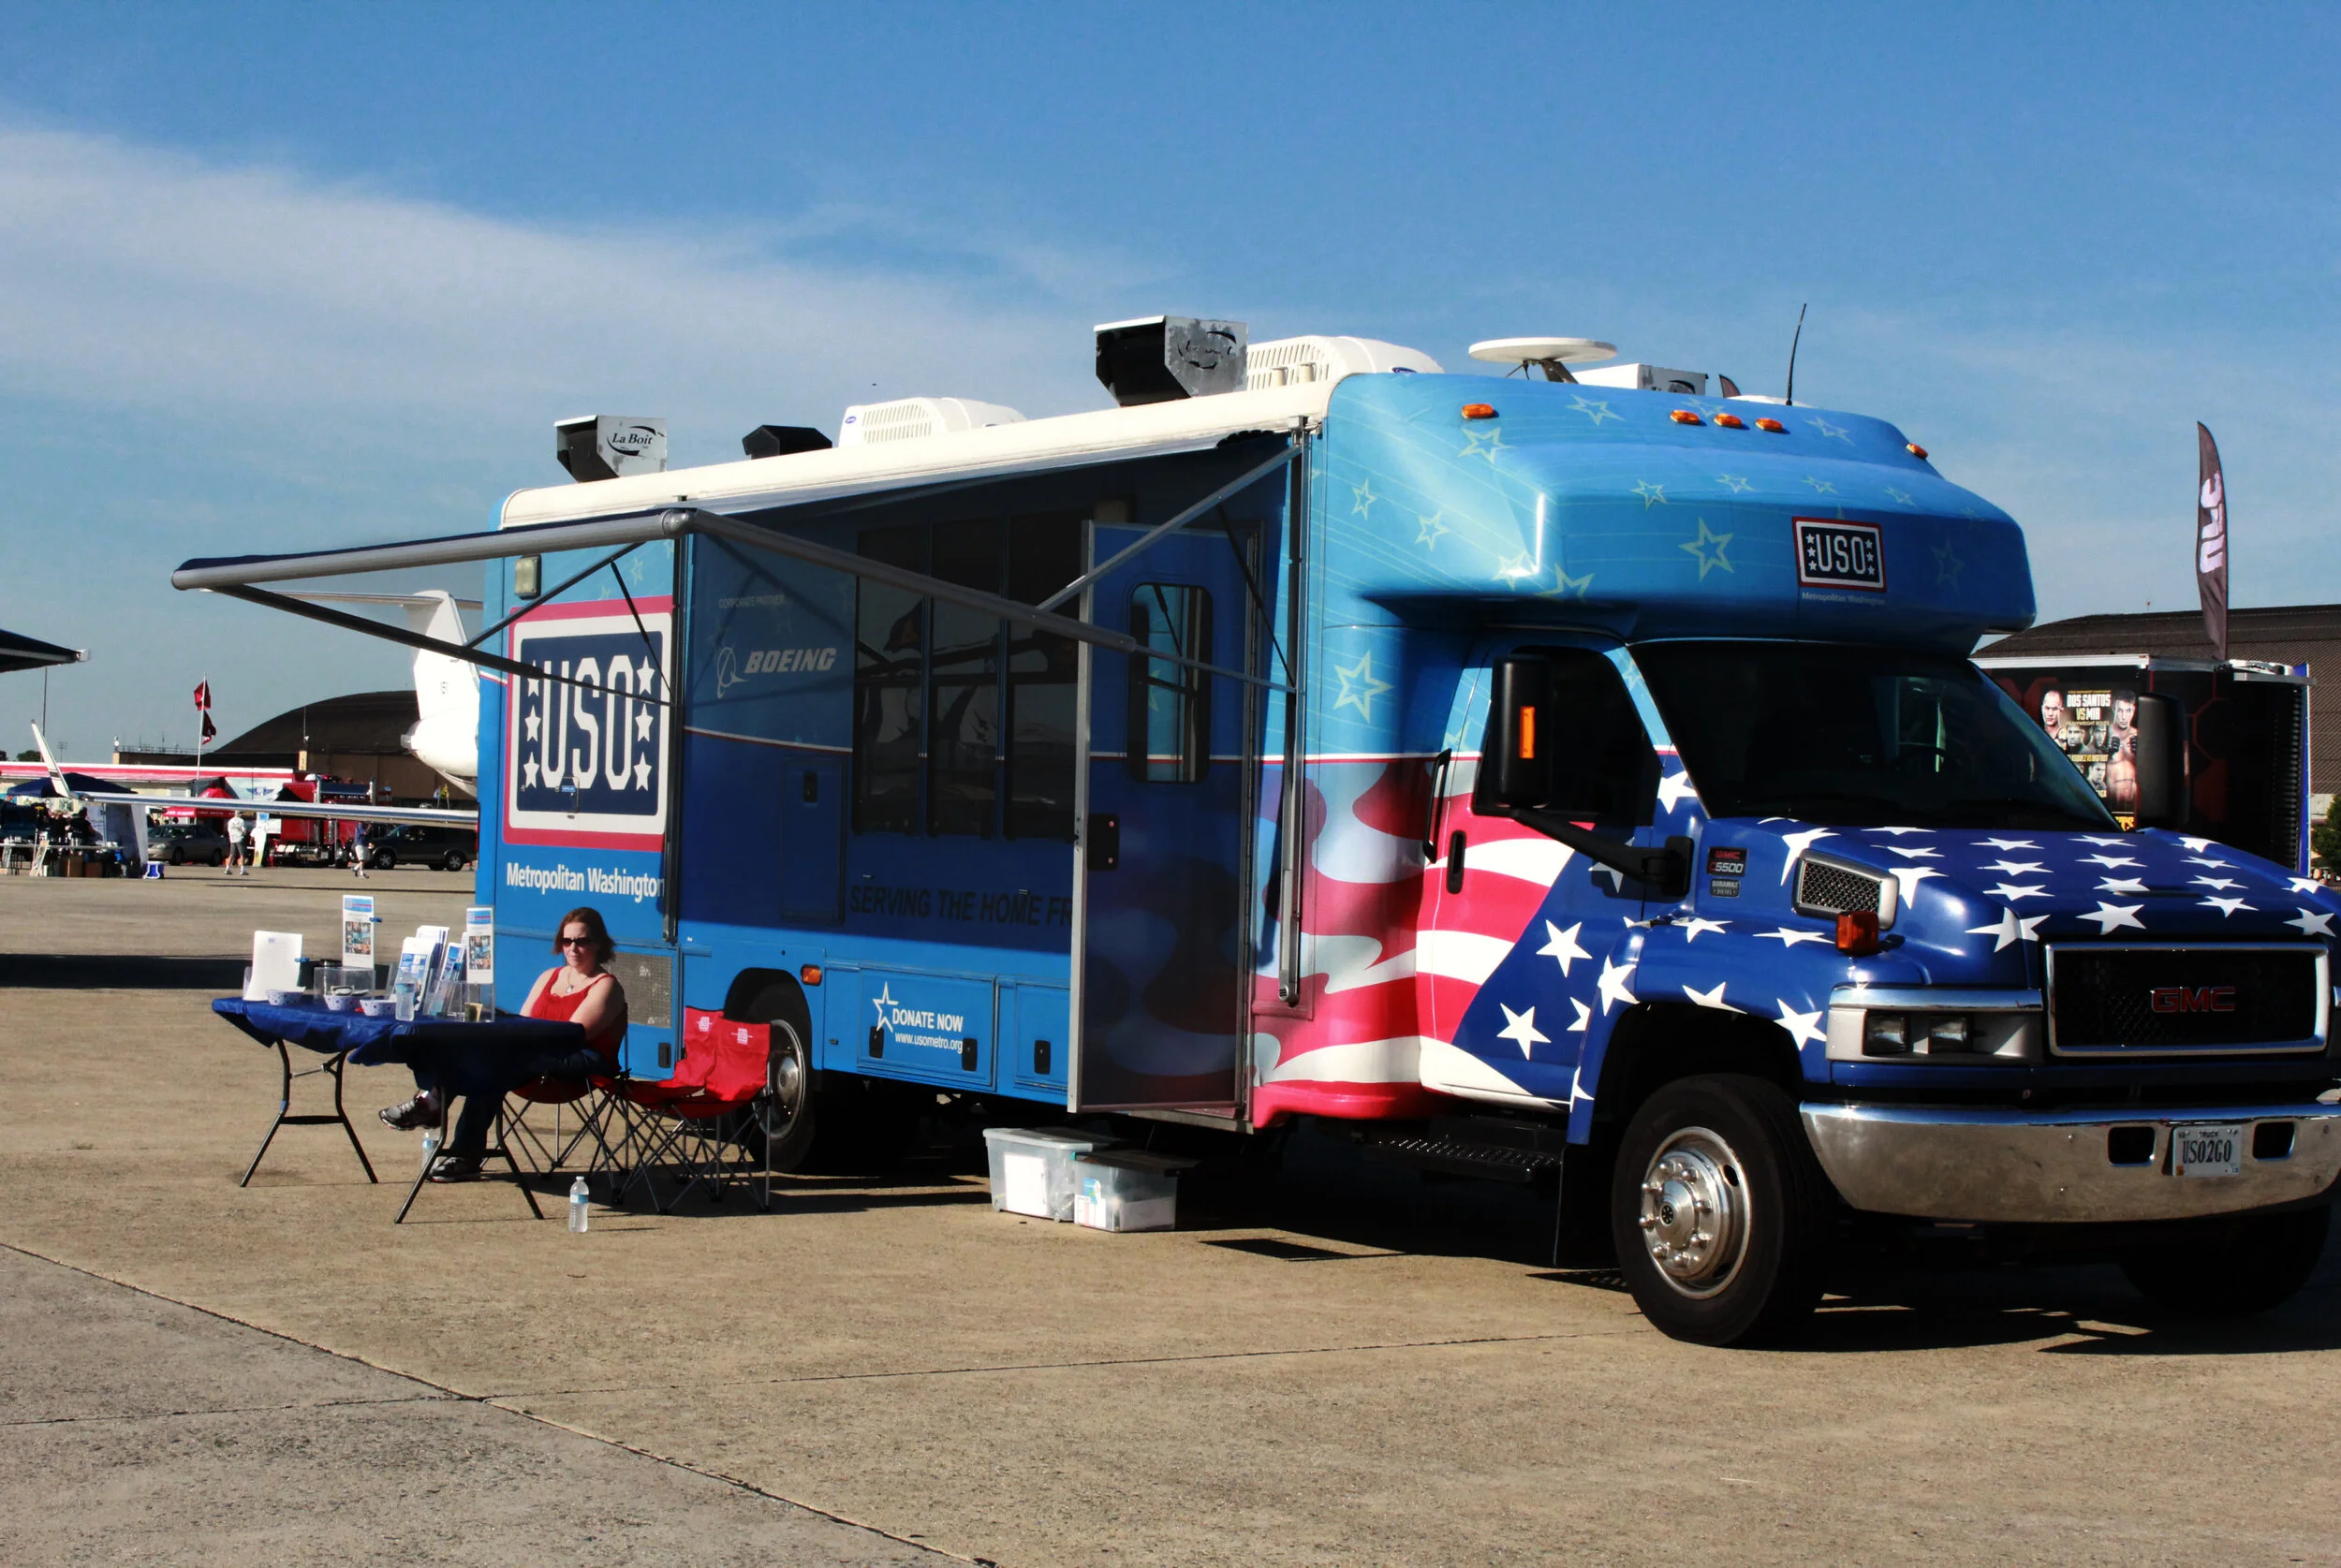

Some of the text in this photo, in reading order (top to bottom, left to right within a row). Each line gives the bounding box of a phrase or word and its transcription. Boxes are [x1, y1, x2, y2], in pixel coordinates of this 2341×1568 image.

[612, 432, 653, 445] La Boit
[1815, 534, 1866, 575] USO
[1802, 592, 1847, 604] Metropolitan
[744, 647, 837, 674] BOEING
[2067, 694, 2112, 708] DOS SANTOS
[540, 654, 634, 790] USO
[2076, 708, 2100, 721] VS MIR
[1709, 861, 1744, 873] C5500
[1715, 850, 1741, 860] GMC
[507, 862, 665, 903] Metropolitan Washington
[849, 885, 932, 918] SERVING
[938, 888, 976, 922] THE
[980, 891, 1042, 927] HOME
[2150, 986, 2236, 1012] GMC
[892, 1007, 964, 1033] DONATE NOW
[895, 1032, 964, 1054] www.usometro.org
